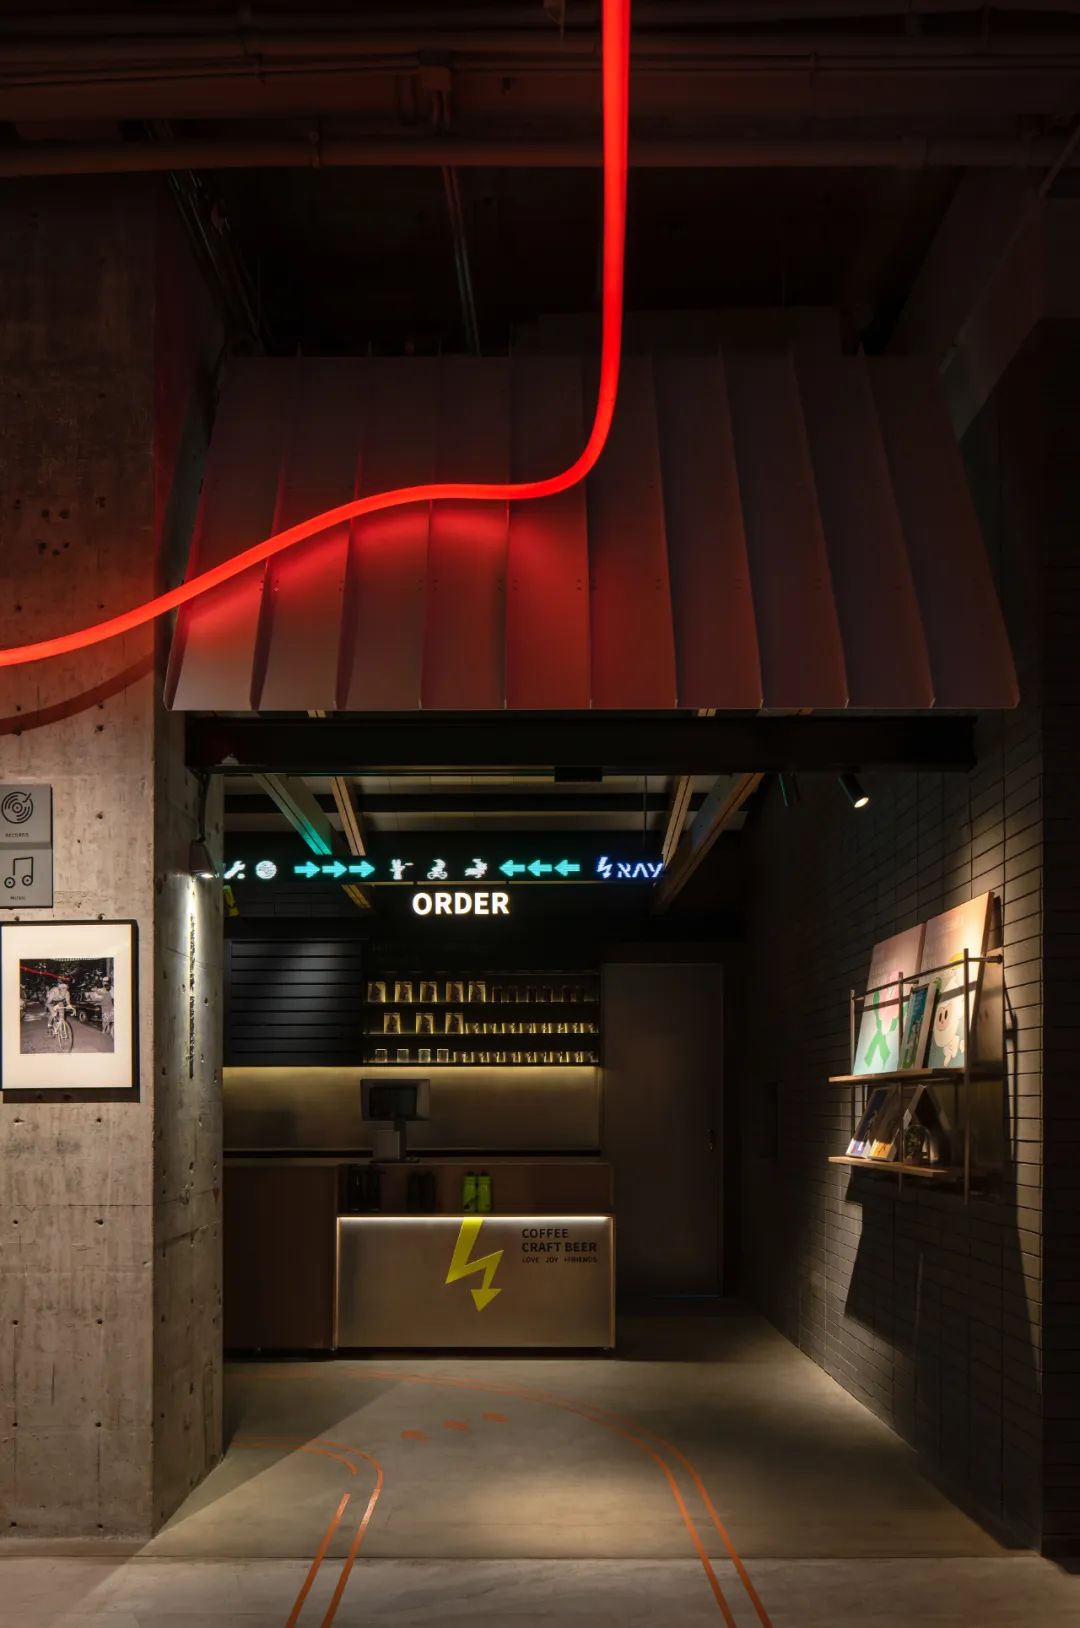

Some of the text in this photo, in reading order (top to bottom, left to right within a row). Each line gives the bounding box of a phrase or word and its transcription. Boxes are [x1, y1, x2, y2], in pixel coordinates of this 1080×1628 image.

[412, 892, 510, 916] ORDER
[521, 1228, 569, 1239] COFFEE
[521, 1242, 597, 1253] CRAFT BEER
[522, 1256, 540, 1264] LOVE
[545, 1256, 559, 1264] JOY
